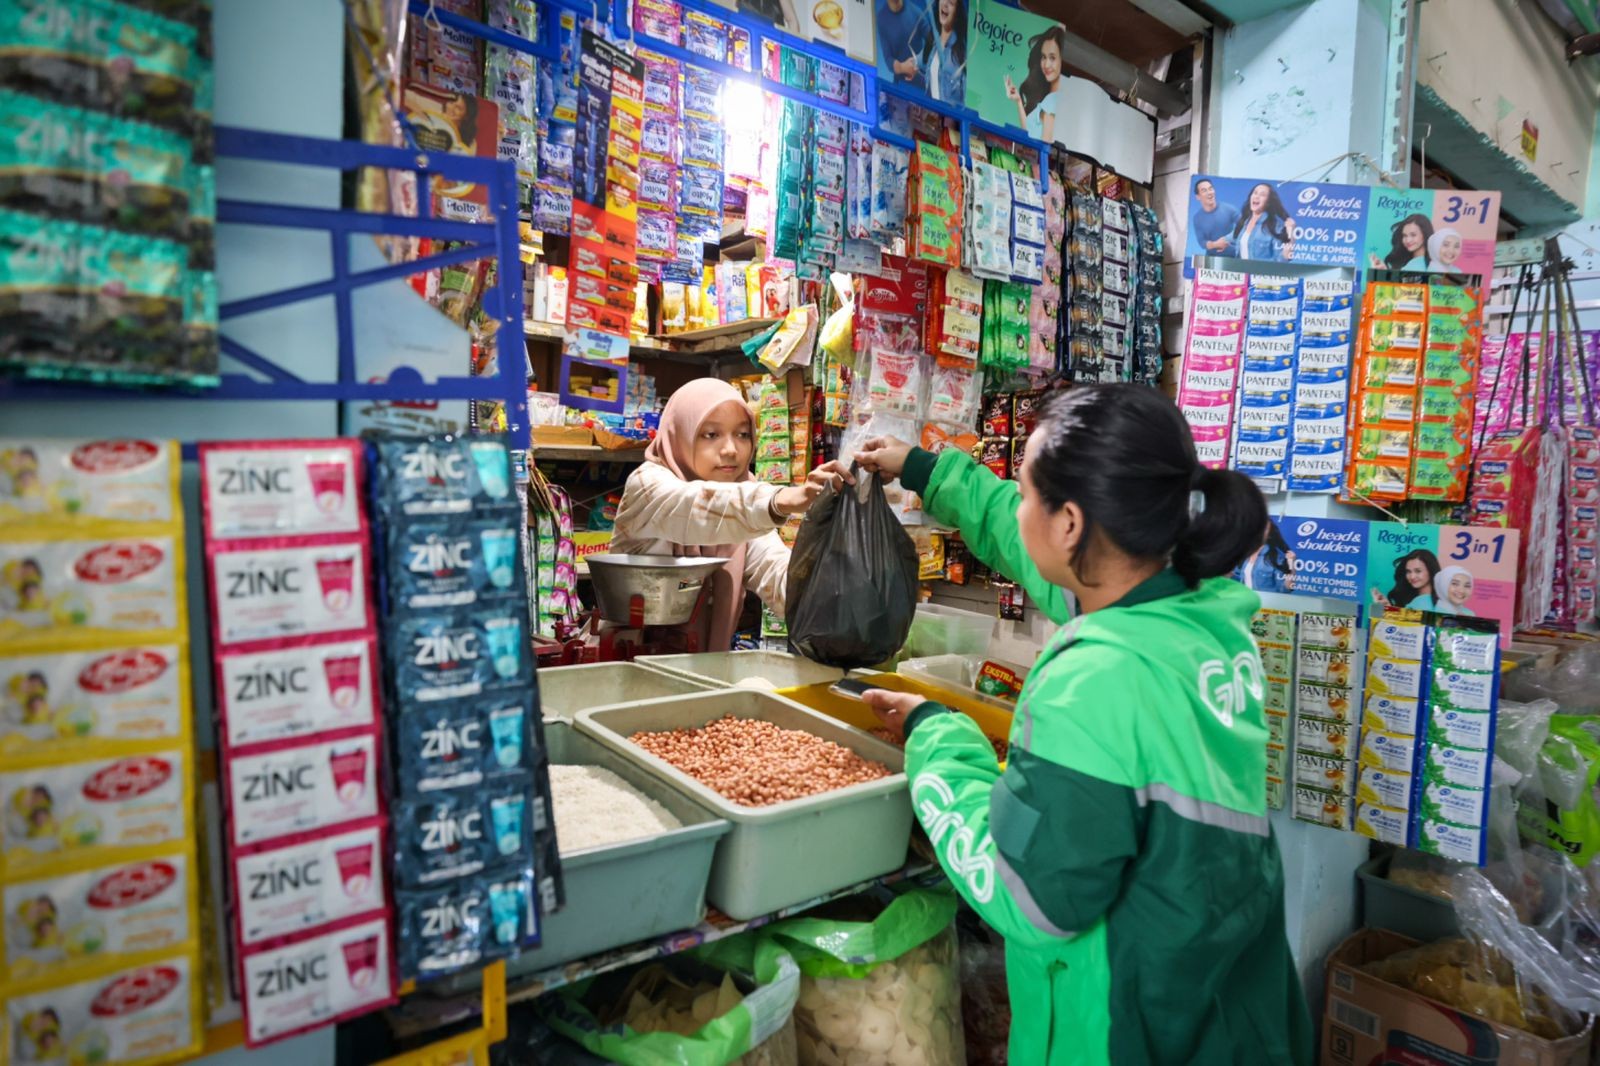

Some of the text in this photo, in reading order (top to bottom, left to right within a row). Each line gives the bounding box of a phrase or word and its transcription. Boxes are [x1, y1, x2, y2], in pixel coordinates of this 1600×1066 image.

[973, 11, 1023, 47] Rejoice
[543, 200, 570, 212] Molto
[1377, 195, 1424, 210] Rejoice
[1296, 205, 1361, 220] shoulders
[1442, 196, 1491, 224] 3 in 1
[1333, 229, 1357, 243] PD
[1306, 280, 1351, 293] PANTENE
[1196, 303, 1240, 317] PANTENE
[1251, 305, 1296, 318] PANTENE
[1304, 315, 1349, 328] PANTENE
[1192, 338, 1235, 353] PANTENE
[1249, 339, 1292, 353] PANTENE
[1301, 351, 1346, 364] PANTENE
[1187, 372, 1231, 388] PANTENE
[1245, 375, 1290, 388] PANTENE
[1298, 387, 1344, 400] PANTENE
[1183, 408, 1227, 423] PANTENE
[1242, 411, 1287, 424] PANTENE
[1296, 423, 1342, 436] PANTENE
[1199, 446, 1223, 458] TENE
[1239, 445, 1284, 458] PANTENE
[1294, 458, 1341, 472] PANTENE
[1377, 529, 1428, 546] Rejoice
[1296, 538, 1361, 553] shoulders
[1449, 531, 1506, 563] 3 in 1
[1334, 562, 1358, 577] PD
[1301, 615, 1353, 629] PANTENE
[1300, 650, 1352, 665] PANTENE
[984, 665, 1015, 683] EKSTRA
[1299, 685, 1350, 700] PANTENE
[1298, 720, 1349, 737] PANTENE
[1297, 755, 1346, 772] PANTENE
